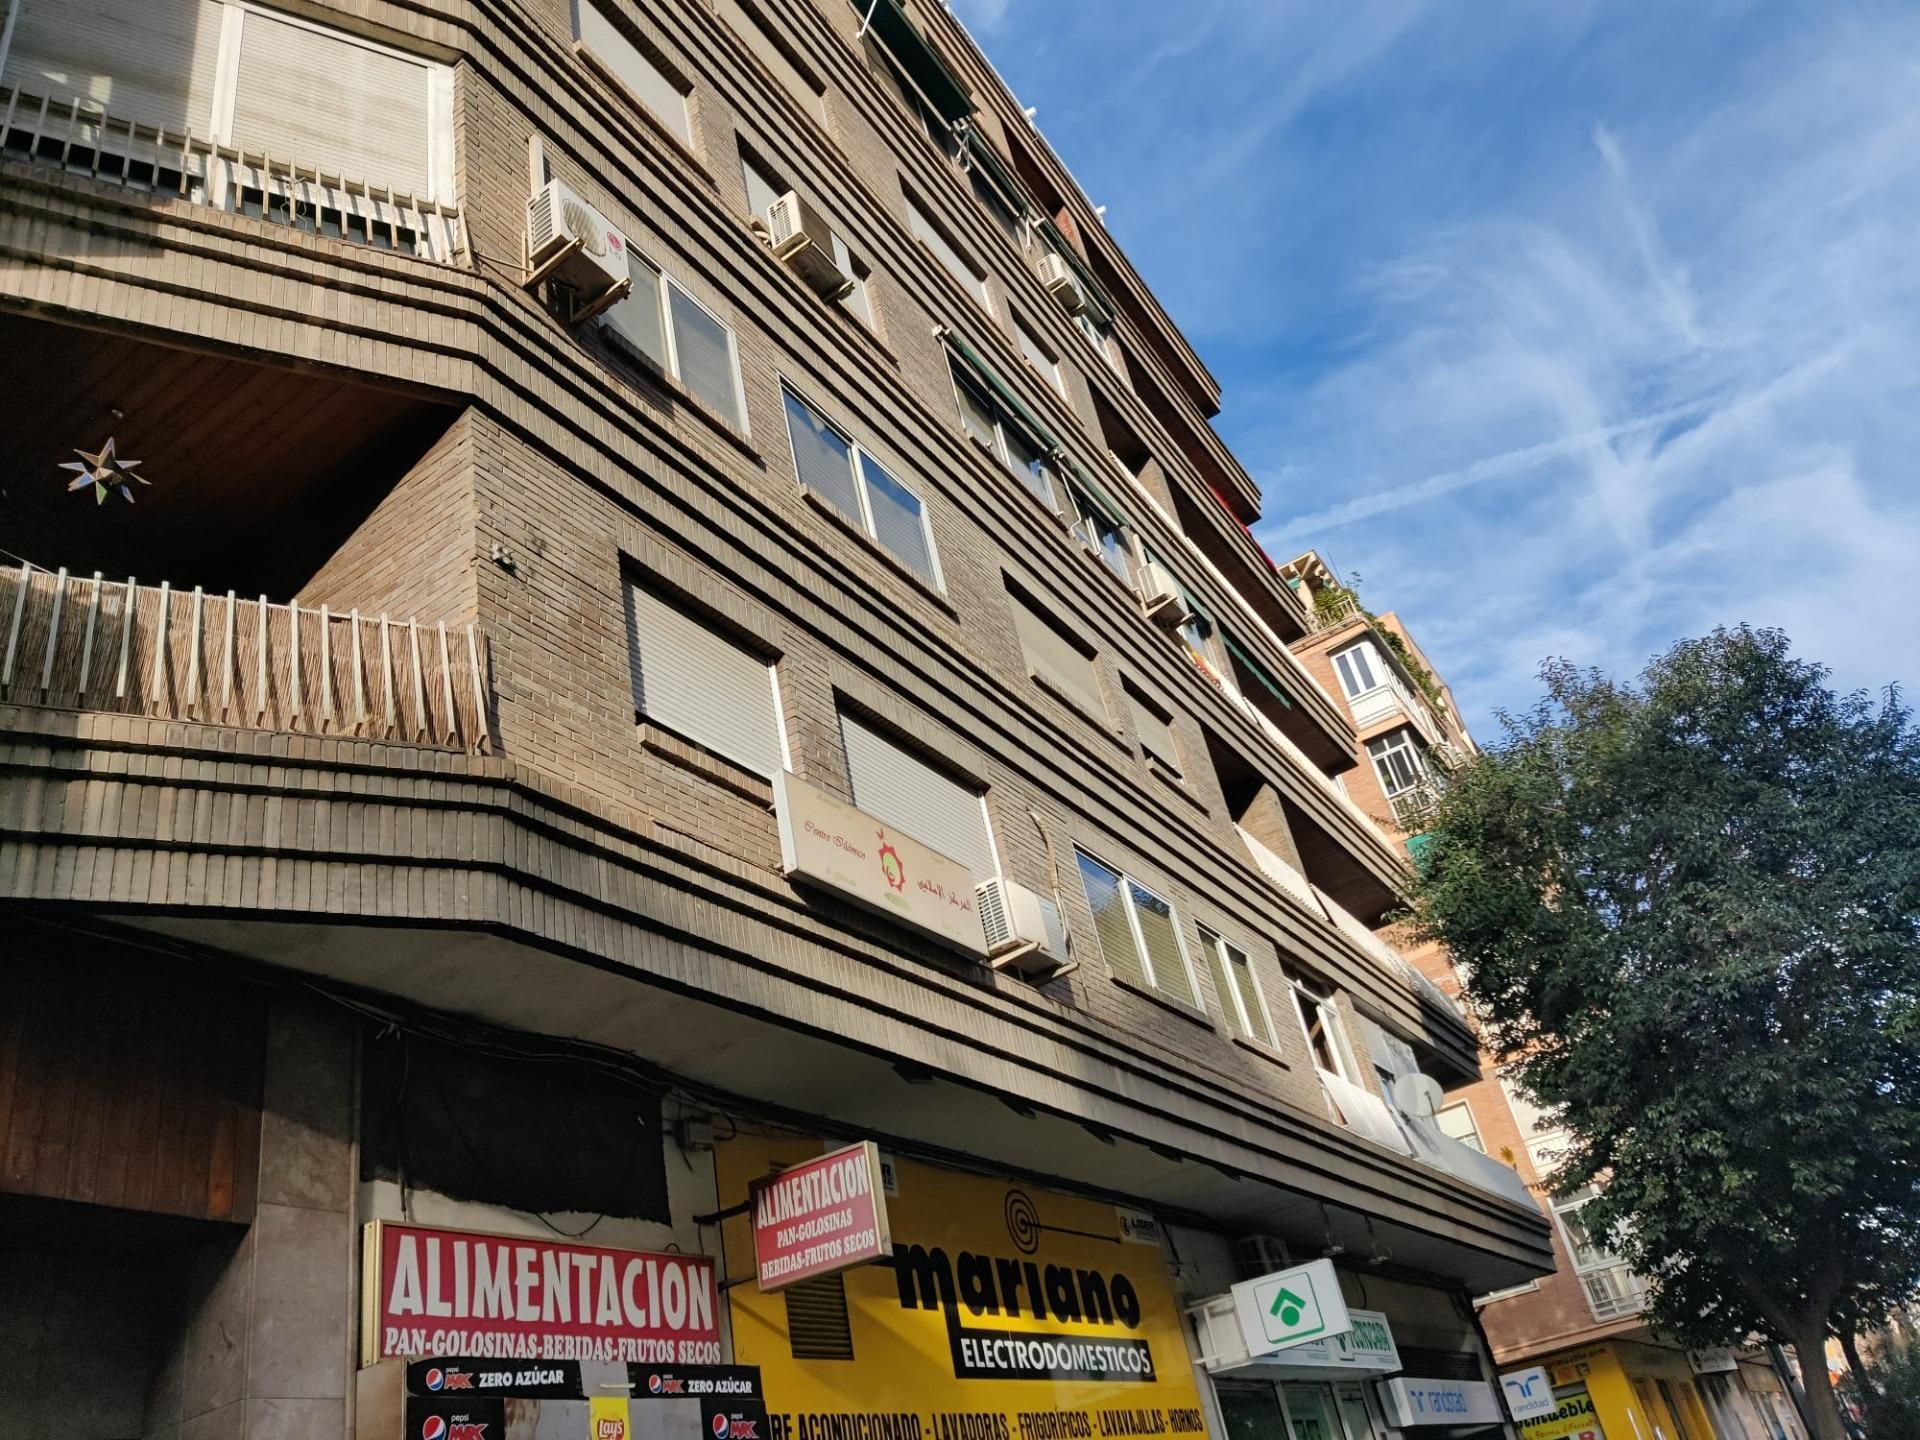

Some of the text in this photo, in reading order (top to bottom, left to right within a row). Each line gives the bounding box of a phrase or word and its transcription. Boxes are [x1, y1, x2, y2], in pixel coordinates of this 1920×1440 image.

[758, 1154, 869, 1229] ALIMENTACION
[777, 1207, 853, 1249] PAN-GOLOSINAS
[762, 1229, 875, 1280] BEBIDAS-FRUTOS SECOS
[388, 1235, 714, 1331] ALIMENTACION
[892, 1243, 1140, 1329] mariano
[678, 1340, 721, 1364] SECOS
[960, 1337, 1151, 1374] ELECTRODOMESTICOS
[445, 1366, 460, 1374] pepsi
[478, 1371, 513, 1388] ZERO
[514, 1365, 564, 1387] AZÚCAR
[687, 1380, 714, 1394] ZERO
[714, 1376, 753, 1394] AZÚCAR
[451, 1413, 470, 1423] pepsi
[1513, 1398, 1550, 1414] randstad
[598, 1419, 624, 1440] Lay's
[798, 1412, 922, 1440] ACONDICIONADO
[932, 1412, 1010, 1440] LAVADORAS
[1096, 1407, 1166, 1437] LAVAVAJILLAS
[1167, 1408, 1204, 1433] HORNOS
